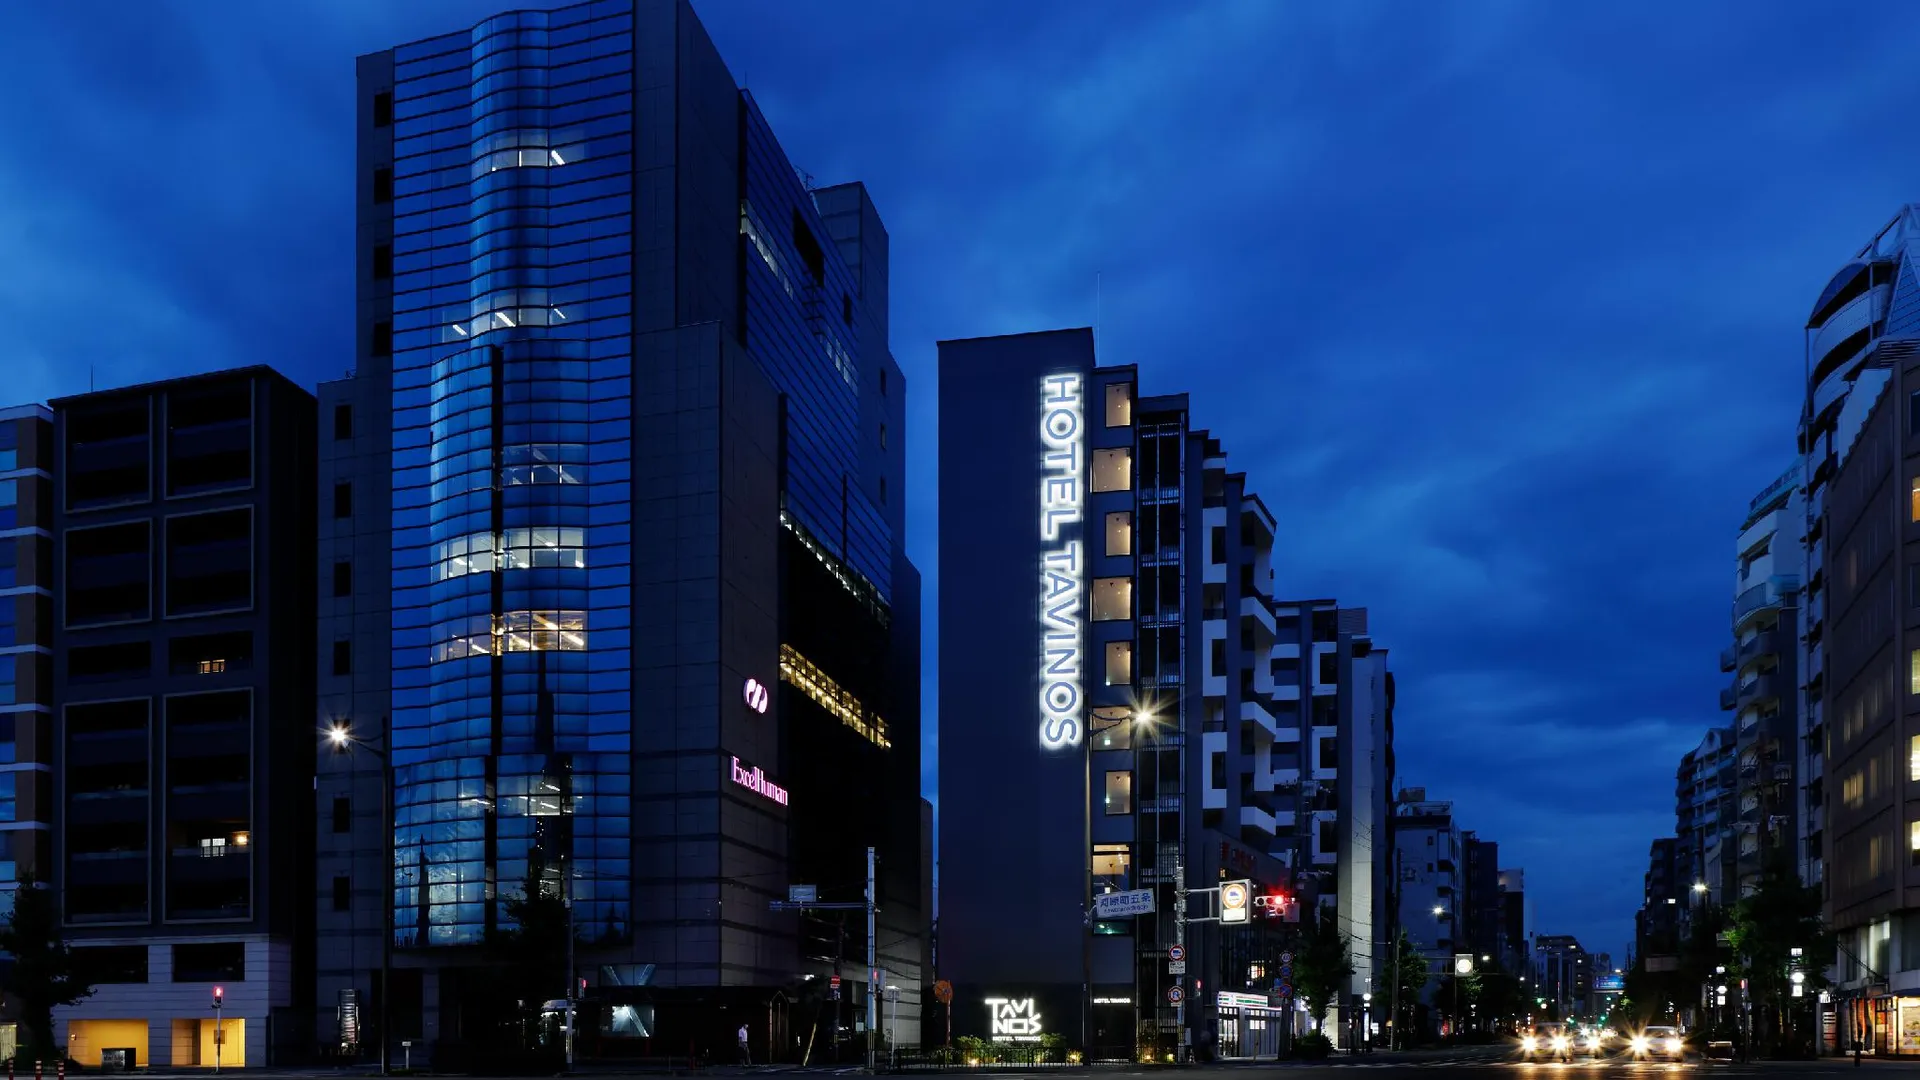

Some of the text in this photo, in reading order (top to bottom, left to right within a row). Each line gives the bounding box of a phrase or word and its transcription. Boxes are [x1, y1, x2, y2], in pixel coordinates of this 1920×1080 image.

[1043, 375, 1079, 745] HOTEL TAVINOS
[985, 998, 1034, 1018] TAVI
[992, 1013, 1042, 1035] NOS
